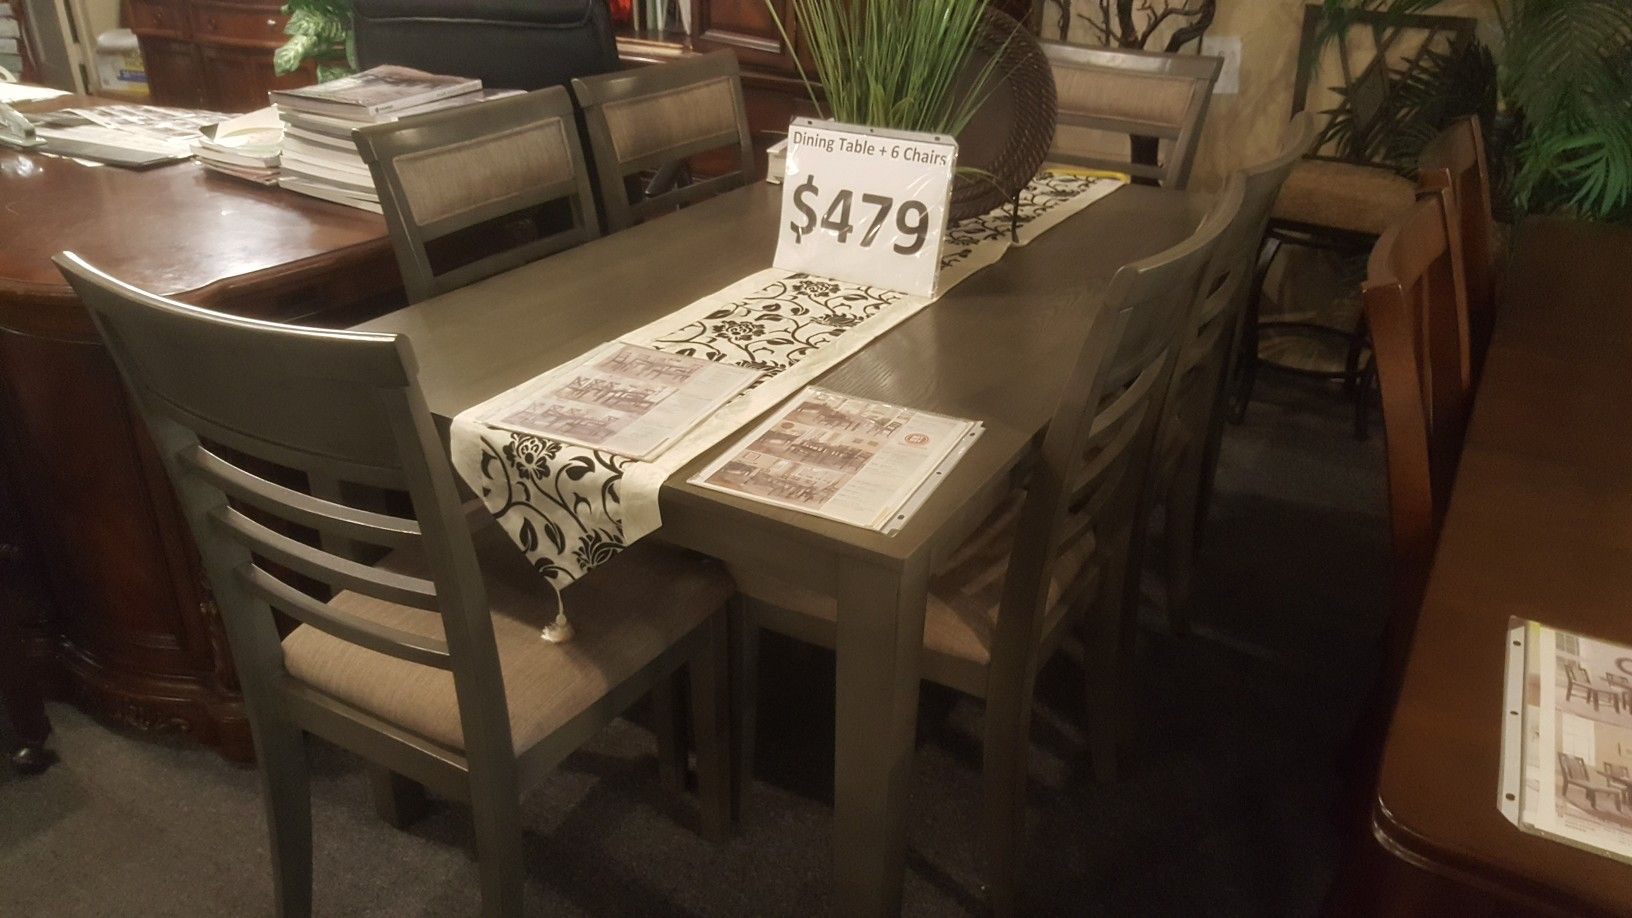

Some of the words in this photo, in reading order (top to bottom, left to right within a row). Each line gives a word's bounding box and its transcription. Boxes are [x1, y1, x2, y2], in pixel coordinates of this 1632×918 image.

[793, 131, 834, 153] Dining
[839, 138, 875, 156] Table
[880, 147, 887, 157] +
[892, 145, 900, 159] 6
[904, 147, 947, 166] Chairs
[791, 174, 929, 255] $479
